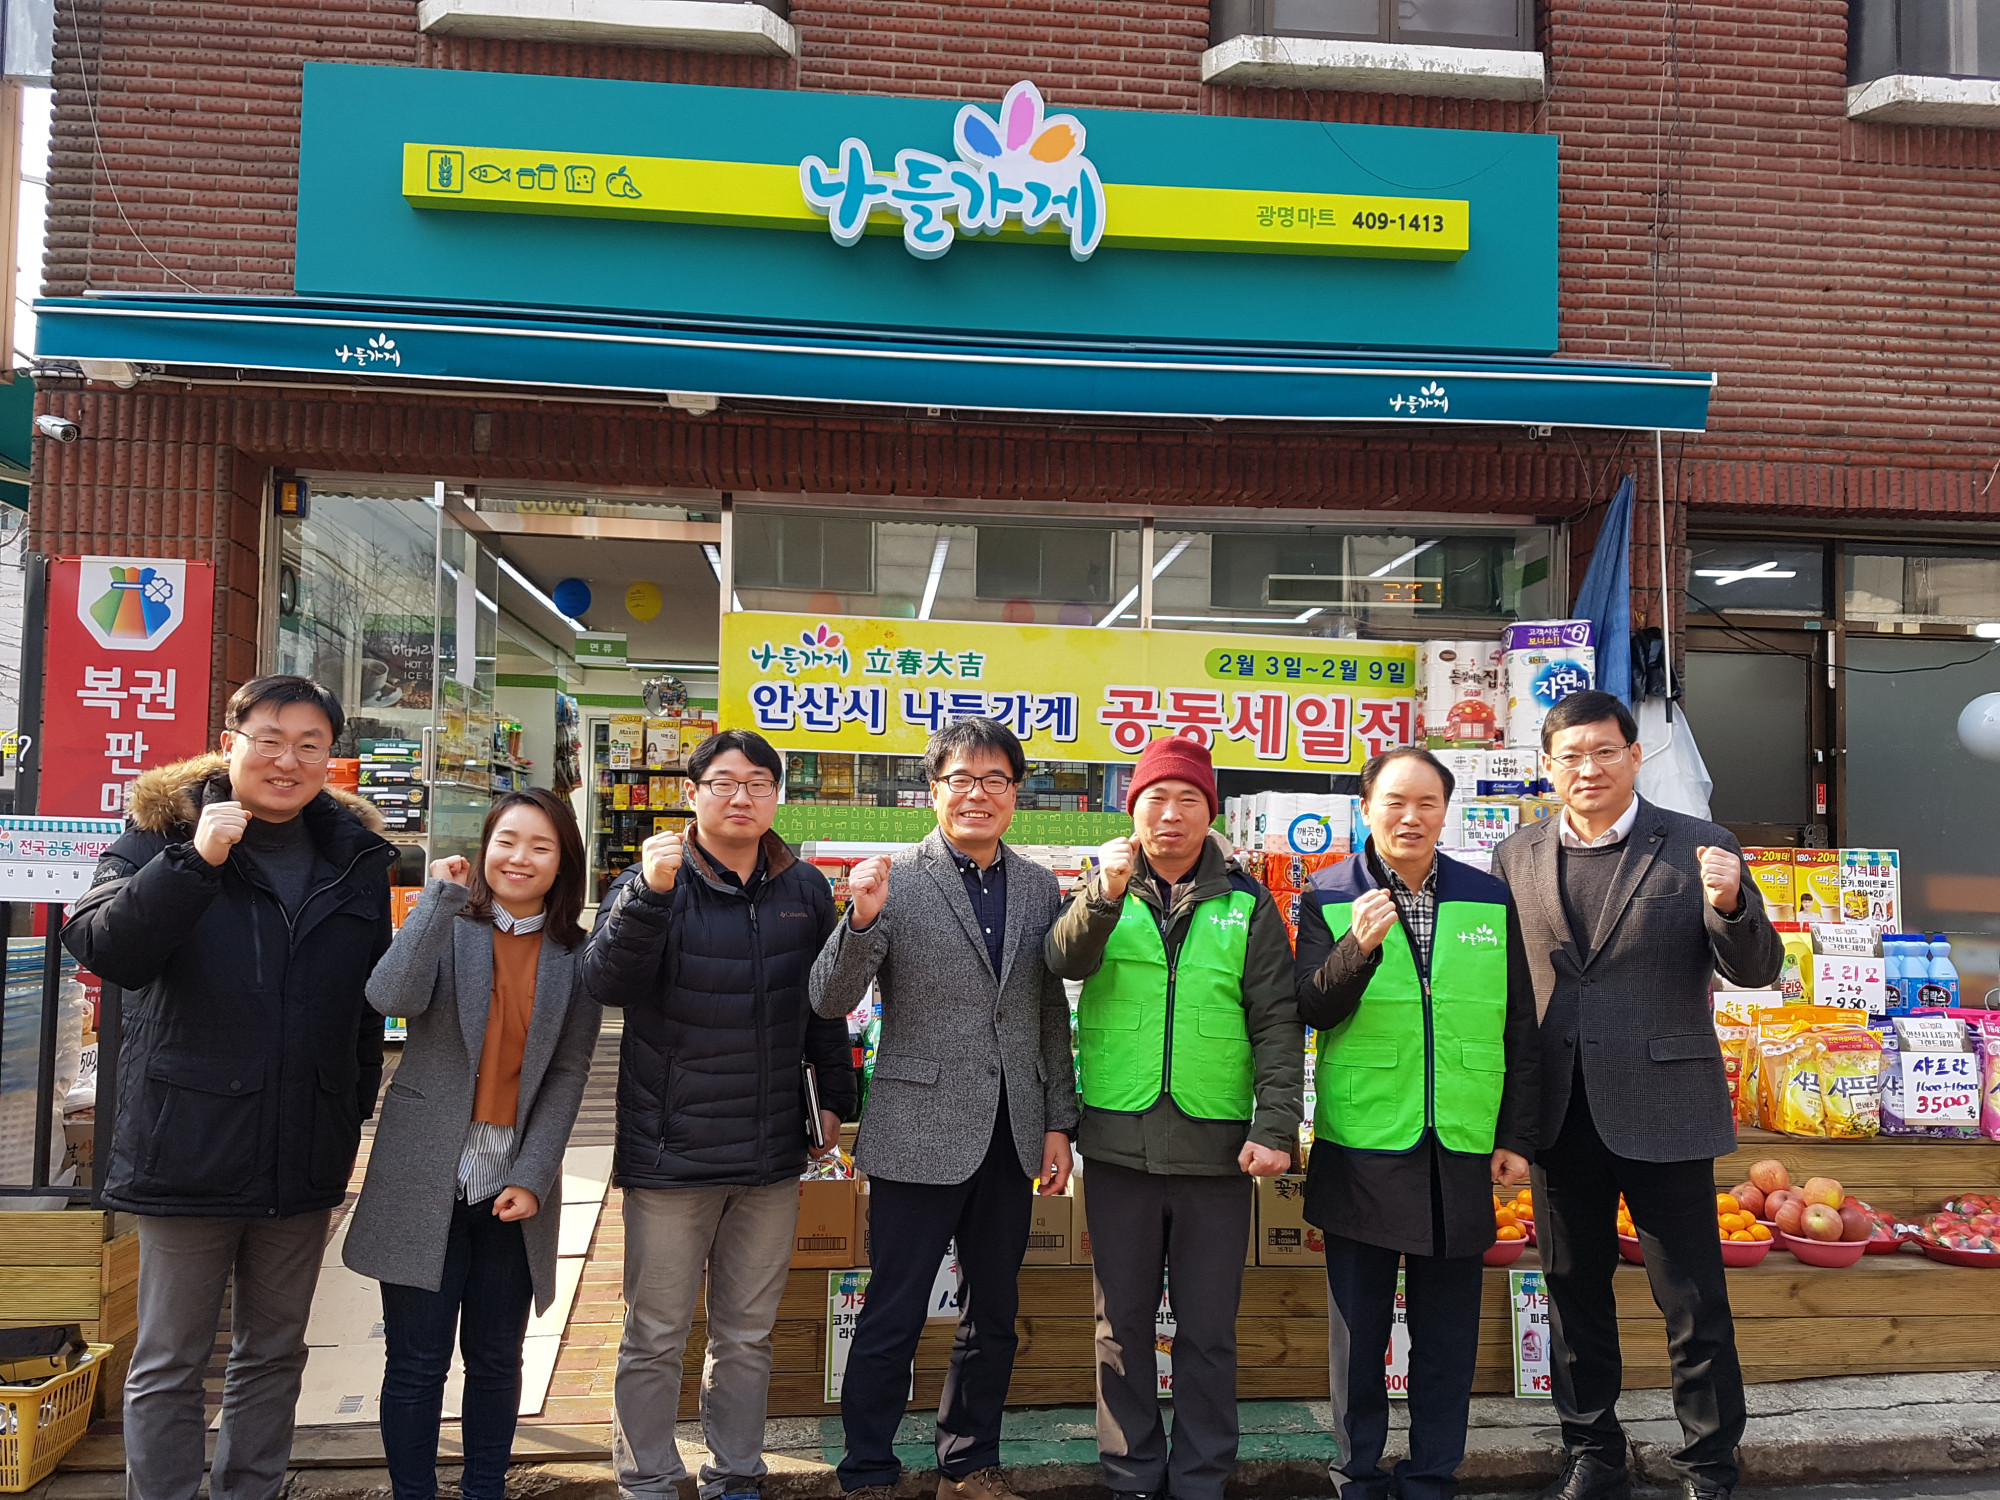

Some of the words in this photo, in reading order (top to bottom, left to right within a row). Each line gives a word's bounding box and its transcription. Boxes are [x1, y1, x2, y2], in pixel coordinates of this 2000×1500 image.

[806, 143, 1101, 252] 나들가게
[1256, 205, 1336, 230] 광명마트
[1352, 211, 1444, 234] 409-1413
[334, 344, 401, 368] 나들가게
[1389, 391, 1450, 415] 나들가게
[404, 659, 423, 671] HOT
[750, 646, 849, 677] 나들가게
[864, 648, 986, 679] 立春大吉
[1218, 653, 1256, 677] 2월
[1264, 656, 1359, 682] 3일~2월
[1368, 661, 1407, 685] 9일
[404, 671, 423, 683] ICE
[1535, 669, 1586, 700] 자연이
[76, 665, 177, 722] 복권
[752, 684, 886, 736] 안산시
[1101, 688, 1414, 760] 공동세일전
[1491, 766, 1519, 778] 나무야
[1493, 756, 1518, 767] 나무야
[1297, 827, 1324, 837] 깨끗한
[1301, 838, 1318, 847] 나라
[1760, 872, 1789, 885] 맥심
[1208, 914, 1247, 931] 나들가게
[1457, 931, 1498, 947] 나들가게
[1913, 1056, 1970, 1076] 샤프란
[1916, 1094, 1971, 1114] 3500
[1966, 1105, 1977, 1119] 원
